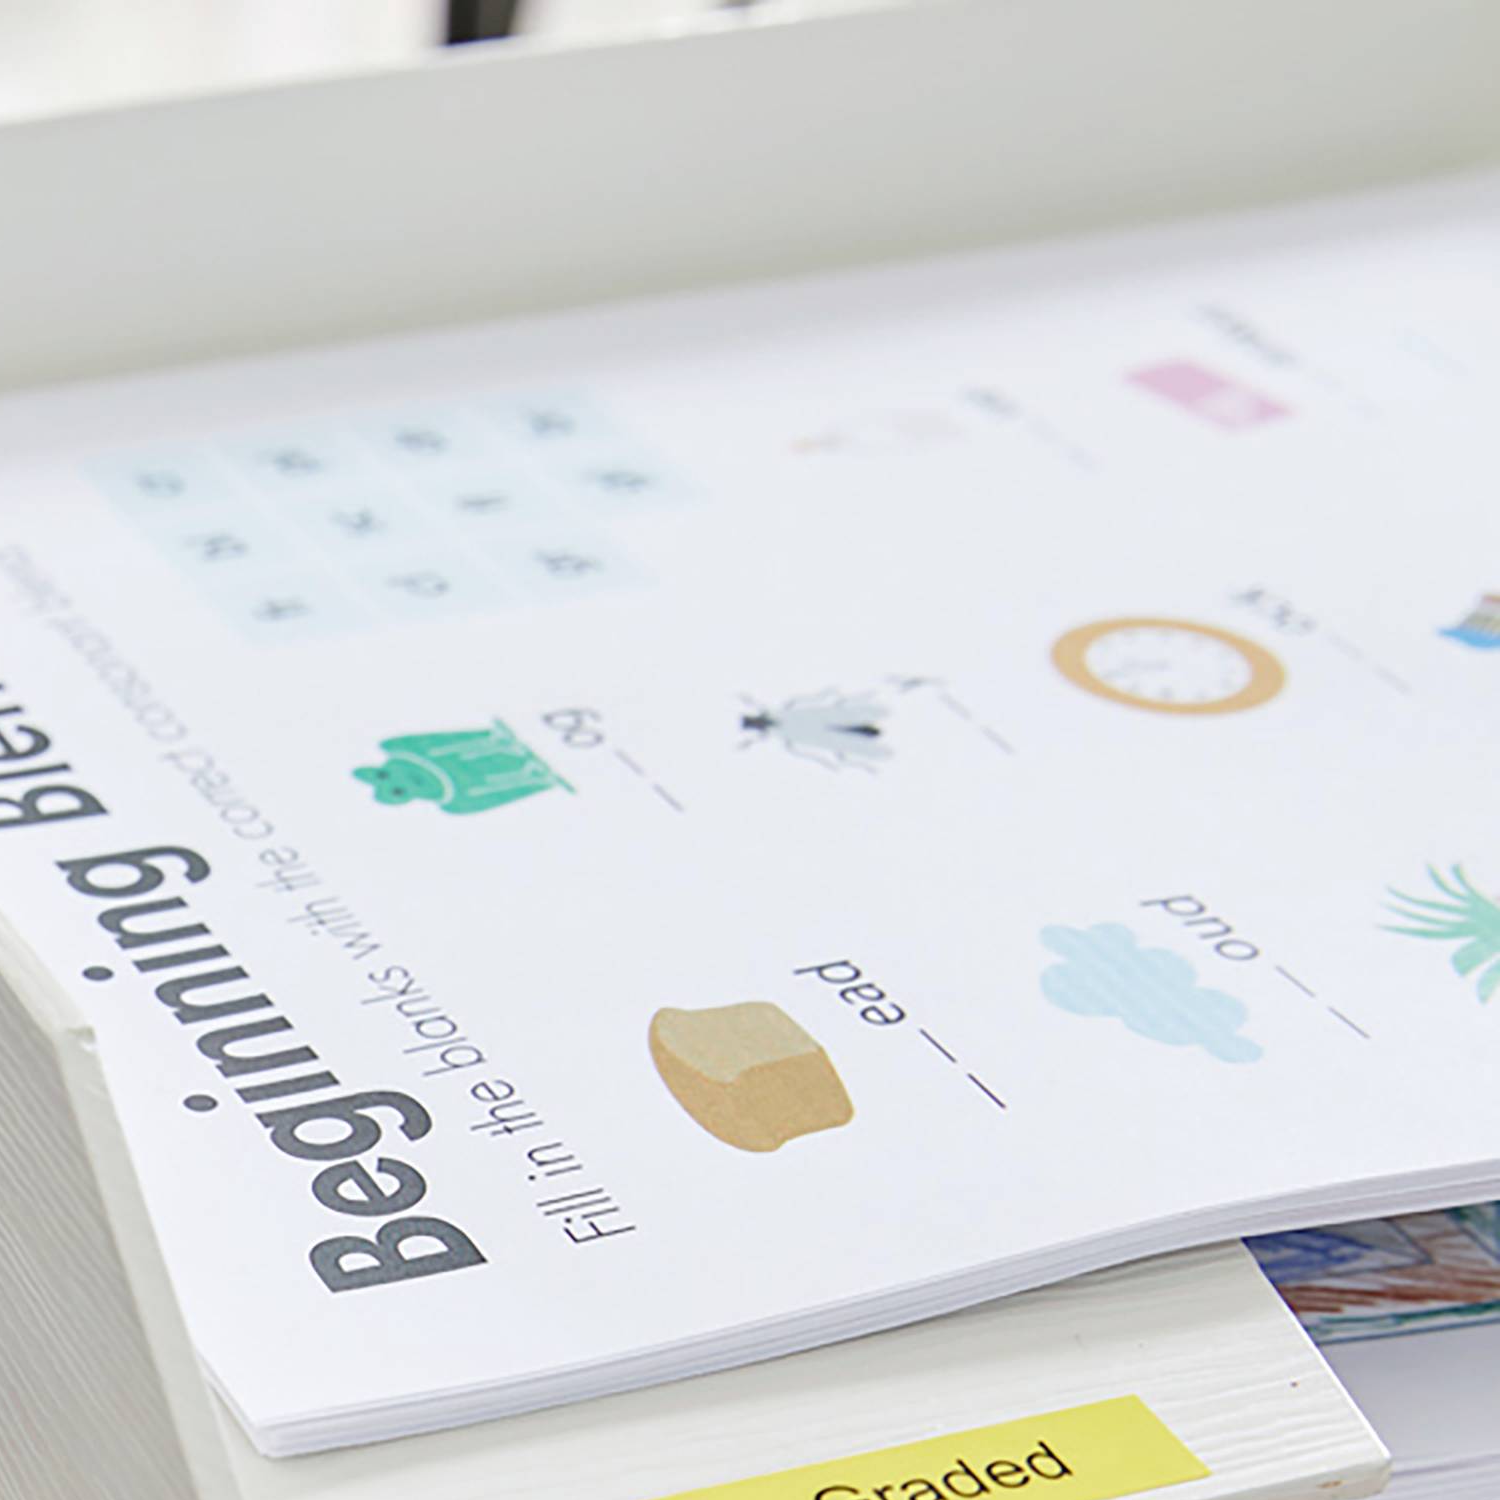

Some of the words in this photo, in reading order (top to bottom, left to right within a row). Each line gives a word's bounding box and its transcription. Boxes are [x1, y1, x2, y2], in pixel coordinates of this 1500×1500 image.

[158, 748, 274, 840] correct
[255, 846, 322, 893] the
[286, 895, 381, 961] with
[1139, 894, 1260, 962] oud
[361, 964, 487, 1077] blanks
[793, 958, 908, 1027] ead
[54, 846, 488, 1293] Beginning
[470, 1078, 544, 1136] the
[526, 1141, 584, 1182] in
[535, 1187, 638, 1244] Fill
